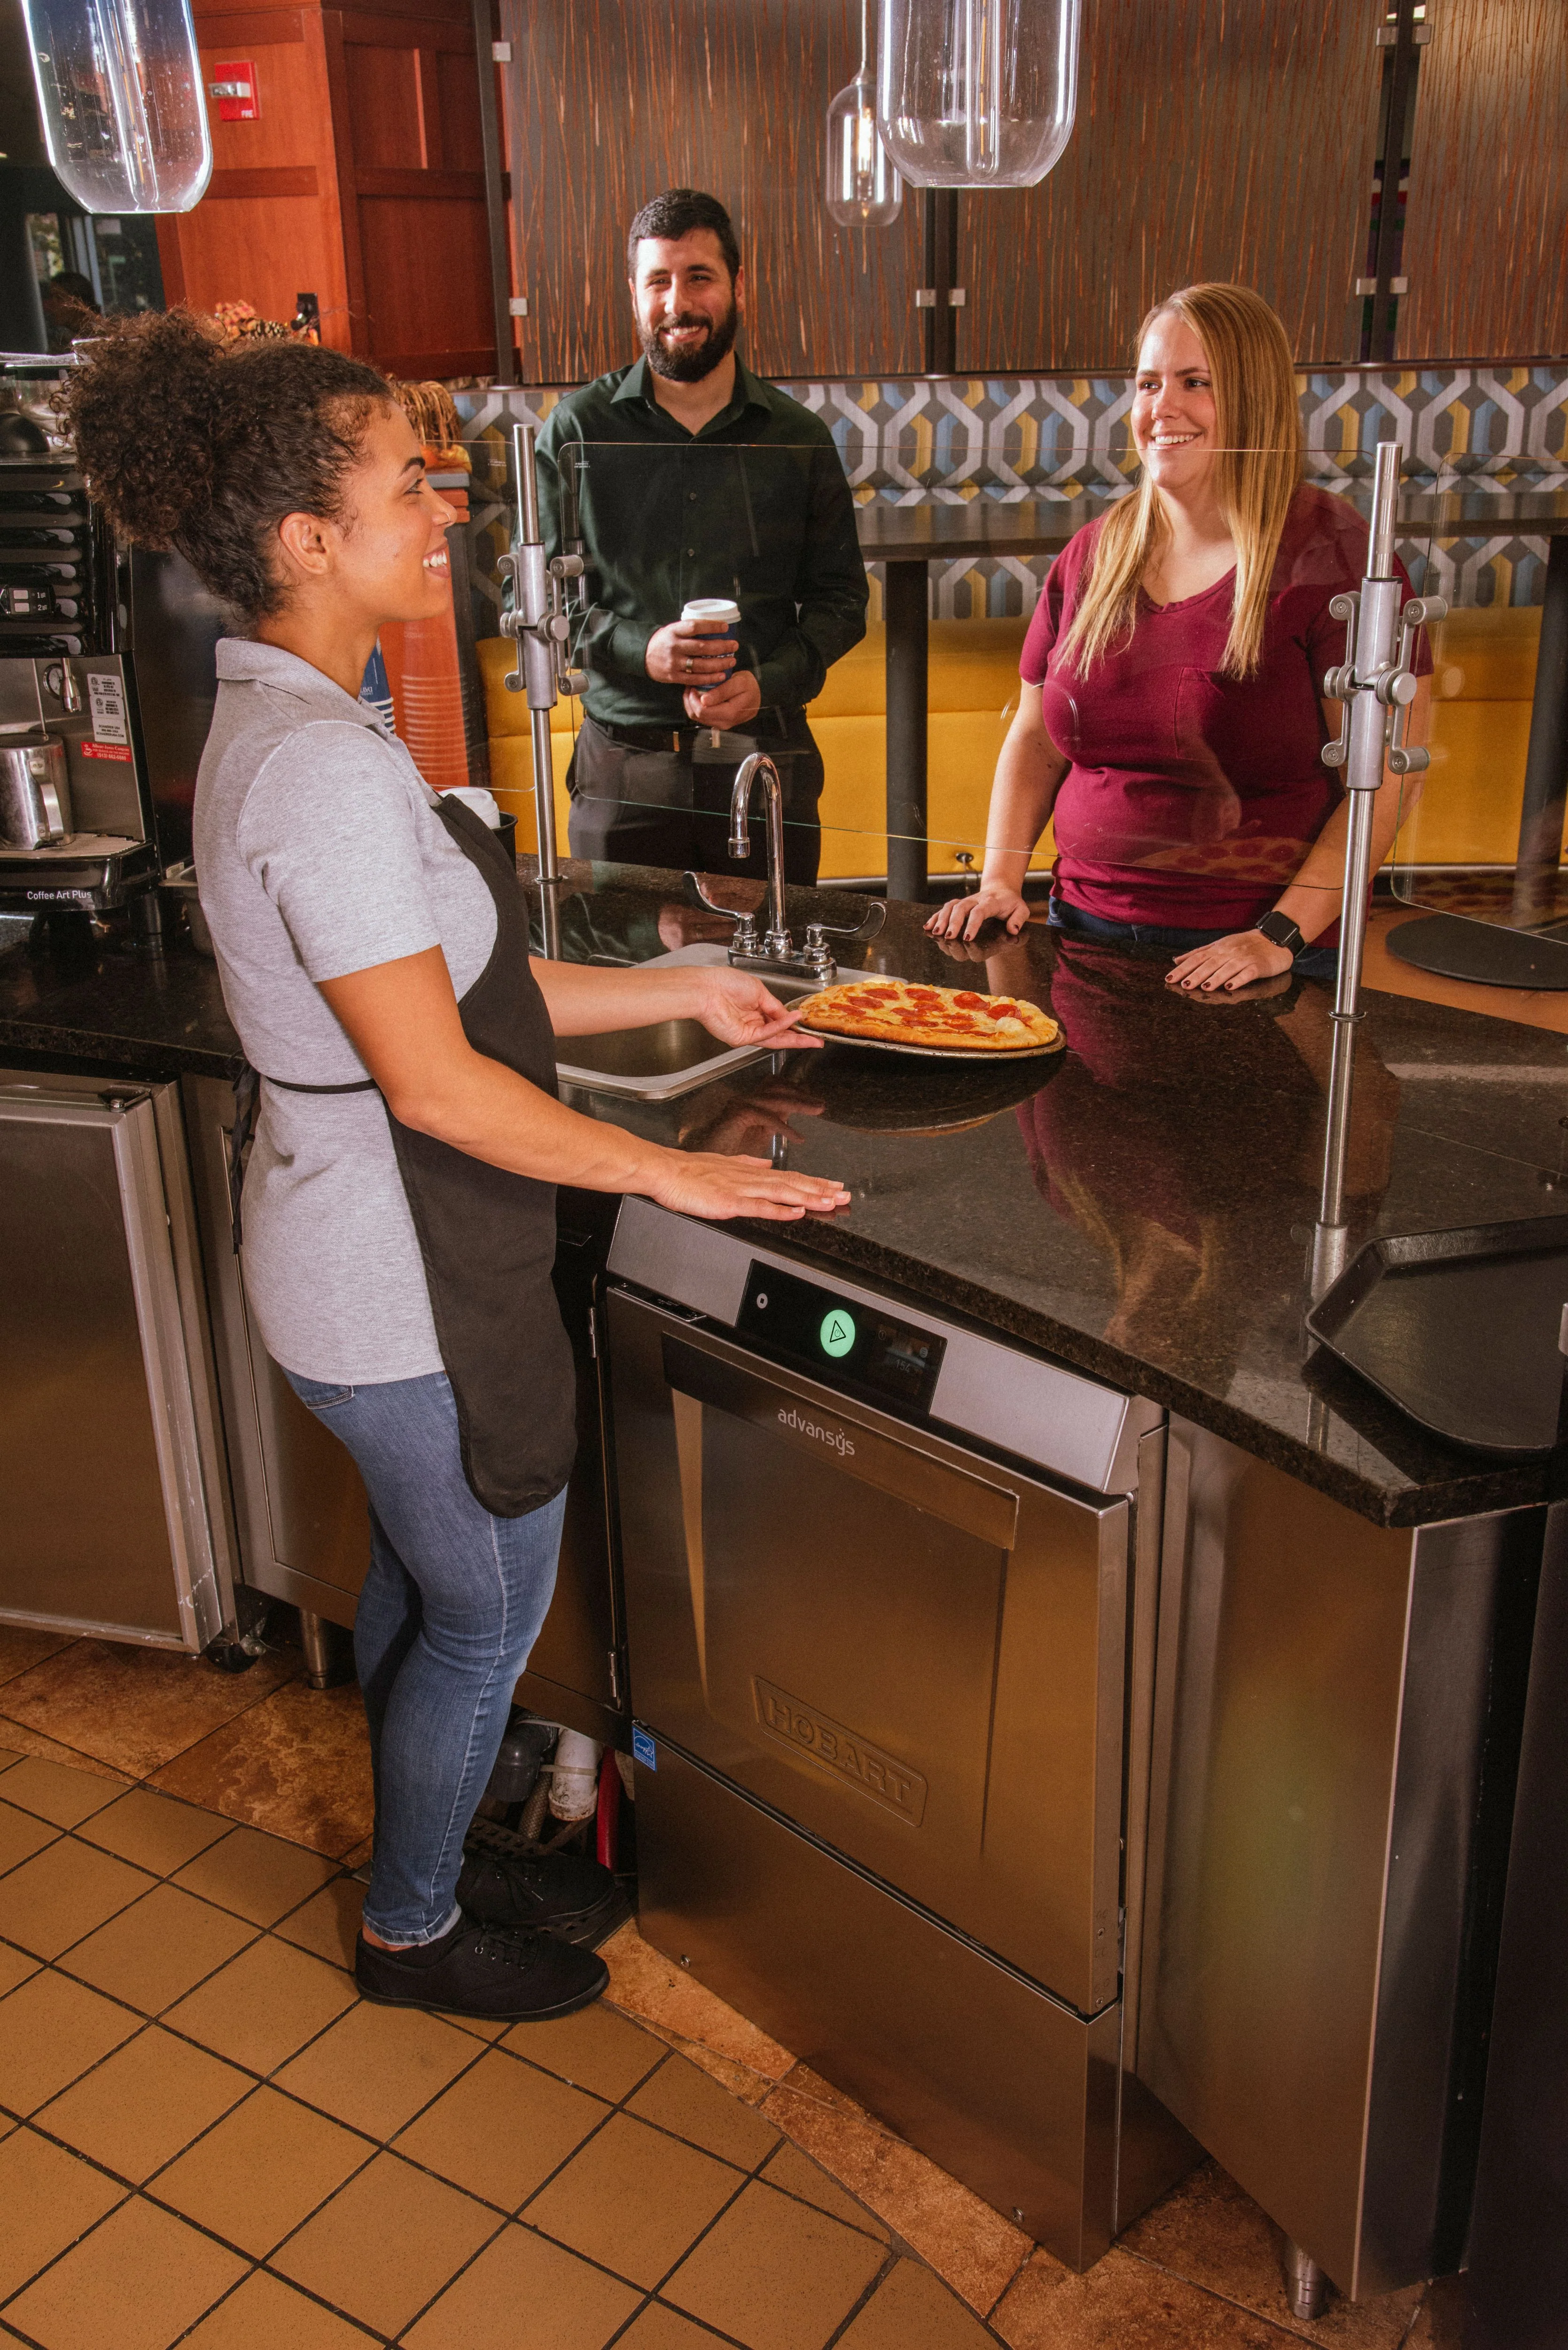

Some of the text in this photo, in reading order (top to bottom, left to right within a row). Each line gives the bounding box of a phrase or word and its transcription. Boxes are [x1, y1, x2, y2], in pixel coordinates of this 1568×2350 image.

[27, 890, 92, 900] Coffee Art Plus
[770, 1697, 911, 1802] HOBART
